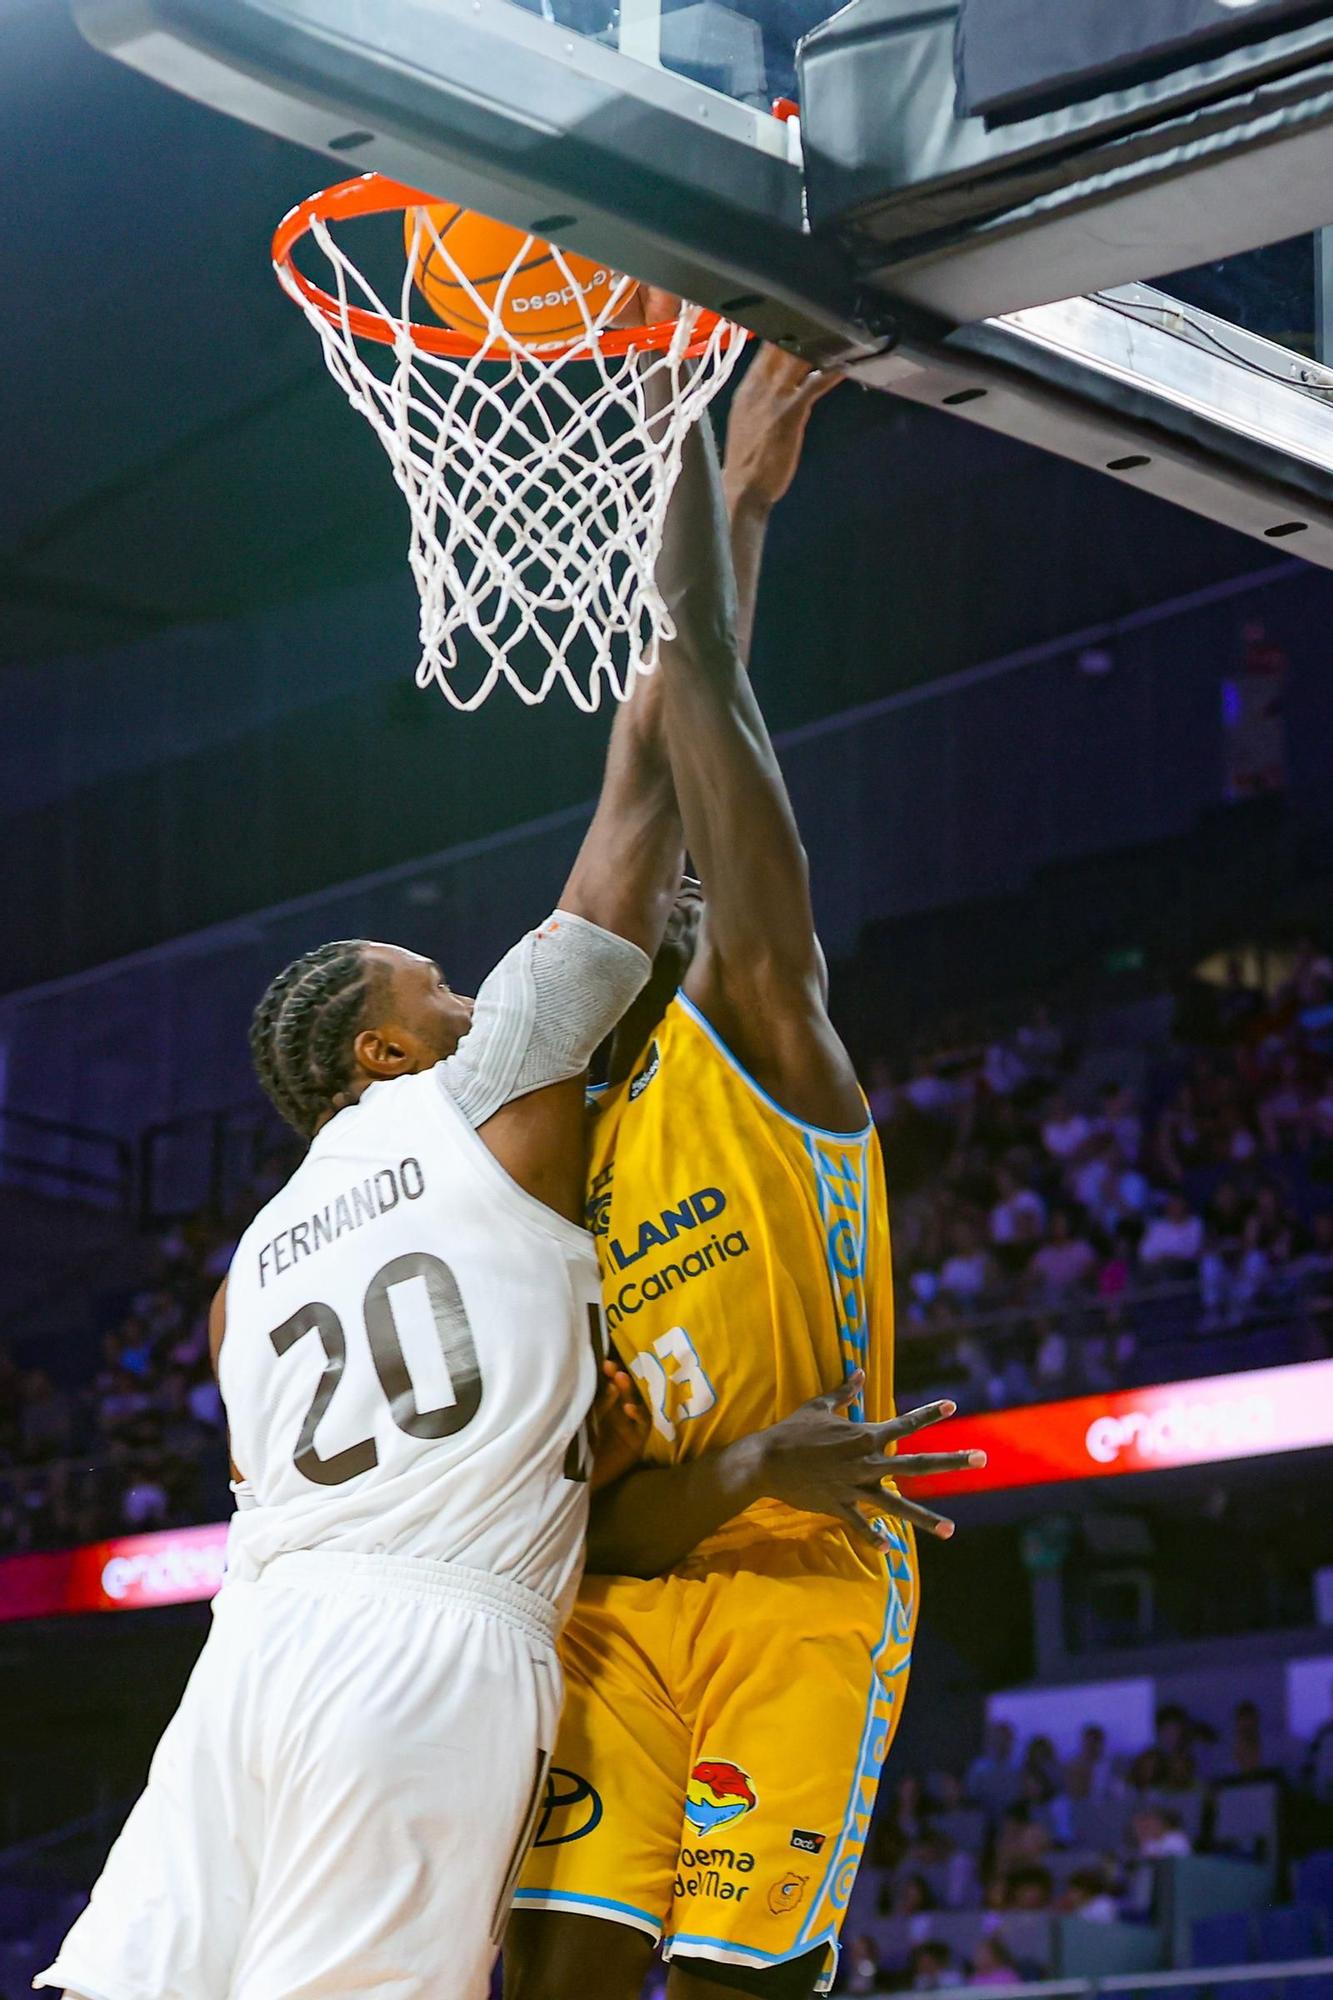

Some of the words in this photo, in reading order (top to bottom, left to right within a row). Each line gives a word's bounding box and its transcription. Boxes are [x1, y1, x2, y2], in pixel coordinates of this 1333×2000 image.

[511, 270, 607, 313] endesa
[259, 1157, 425, 1289] FERNANDO
[606, 1187, 727, 1275] LAND
[606, 1230, 750, 1333] nCanaria
[269, 1252, 483, 1486] 20
[679, 1848, 755, 1873] oema
